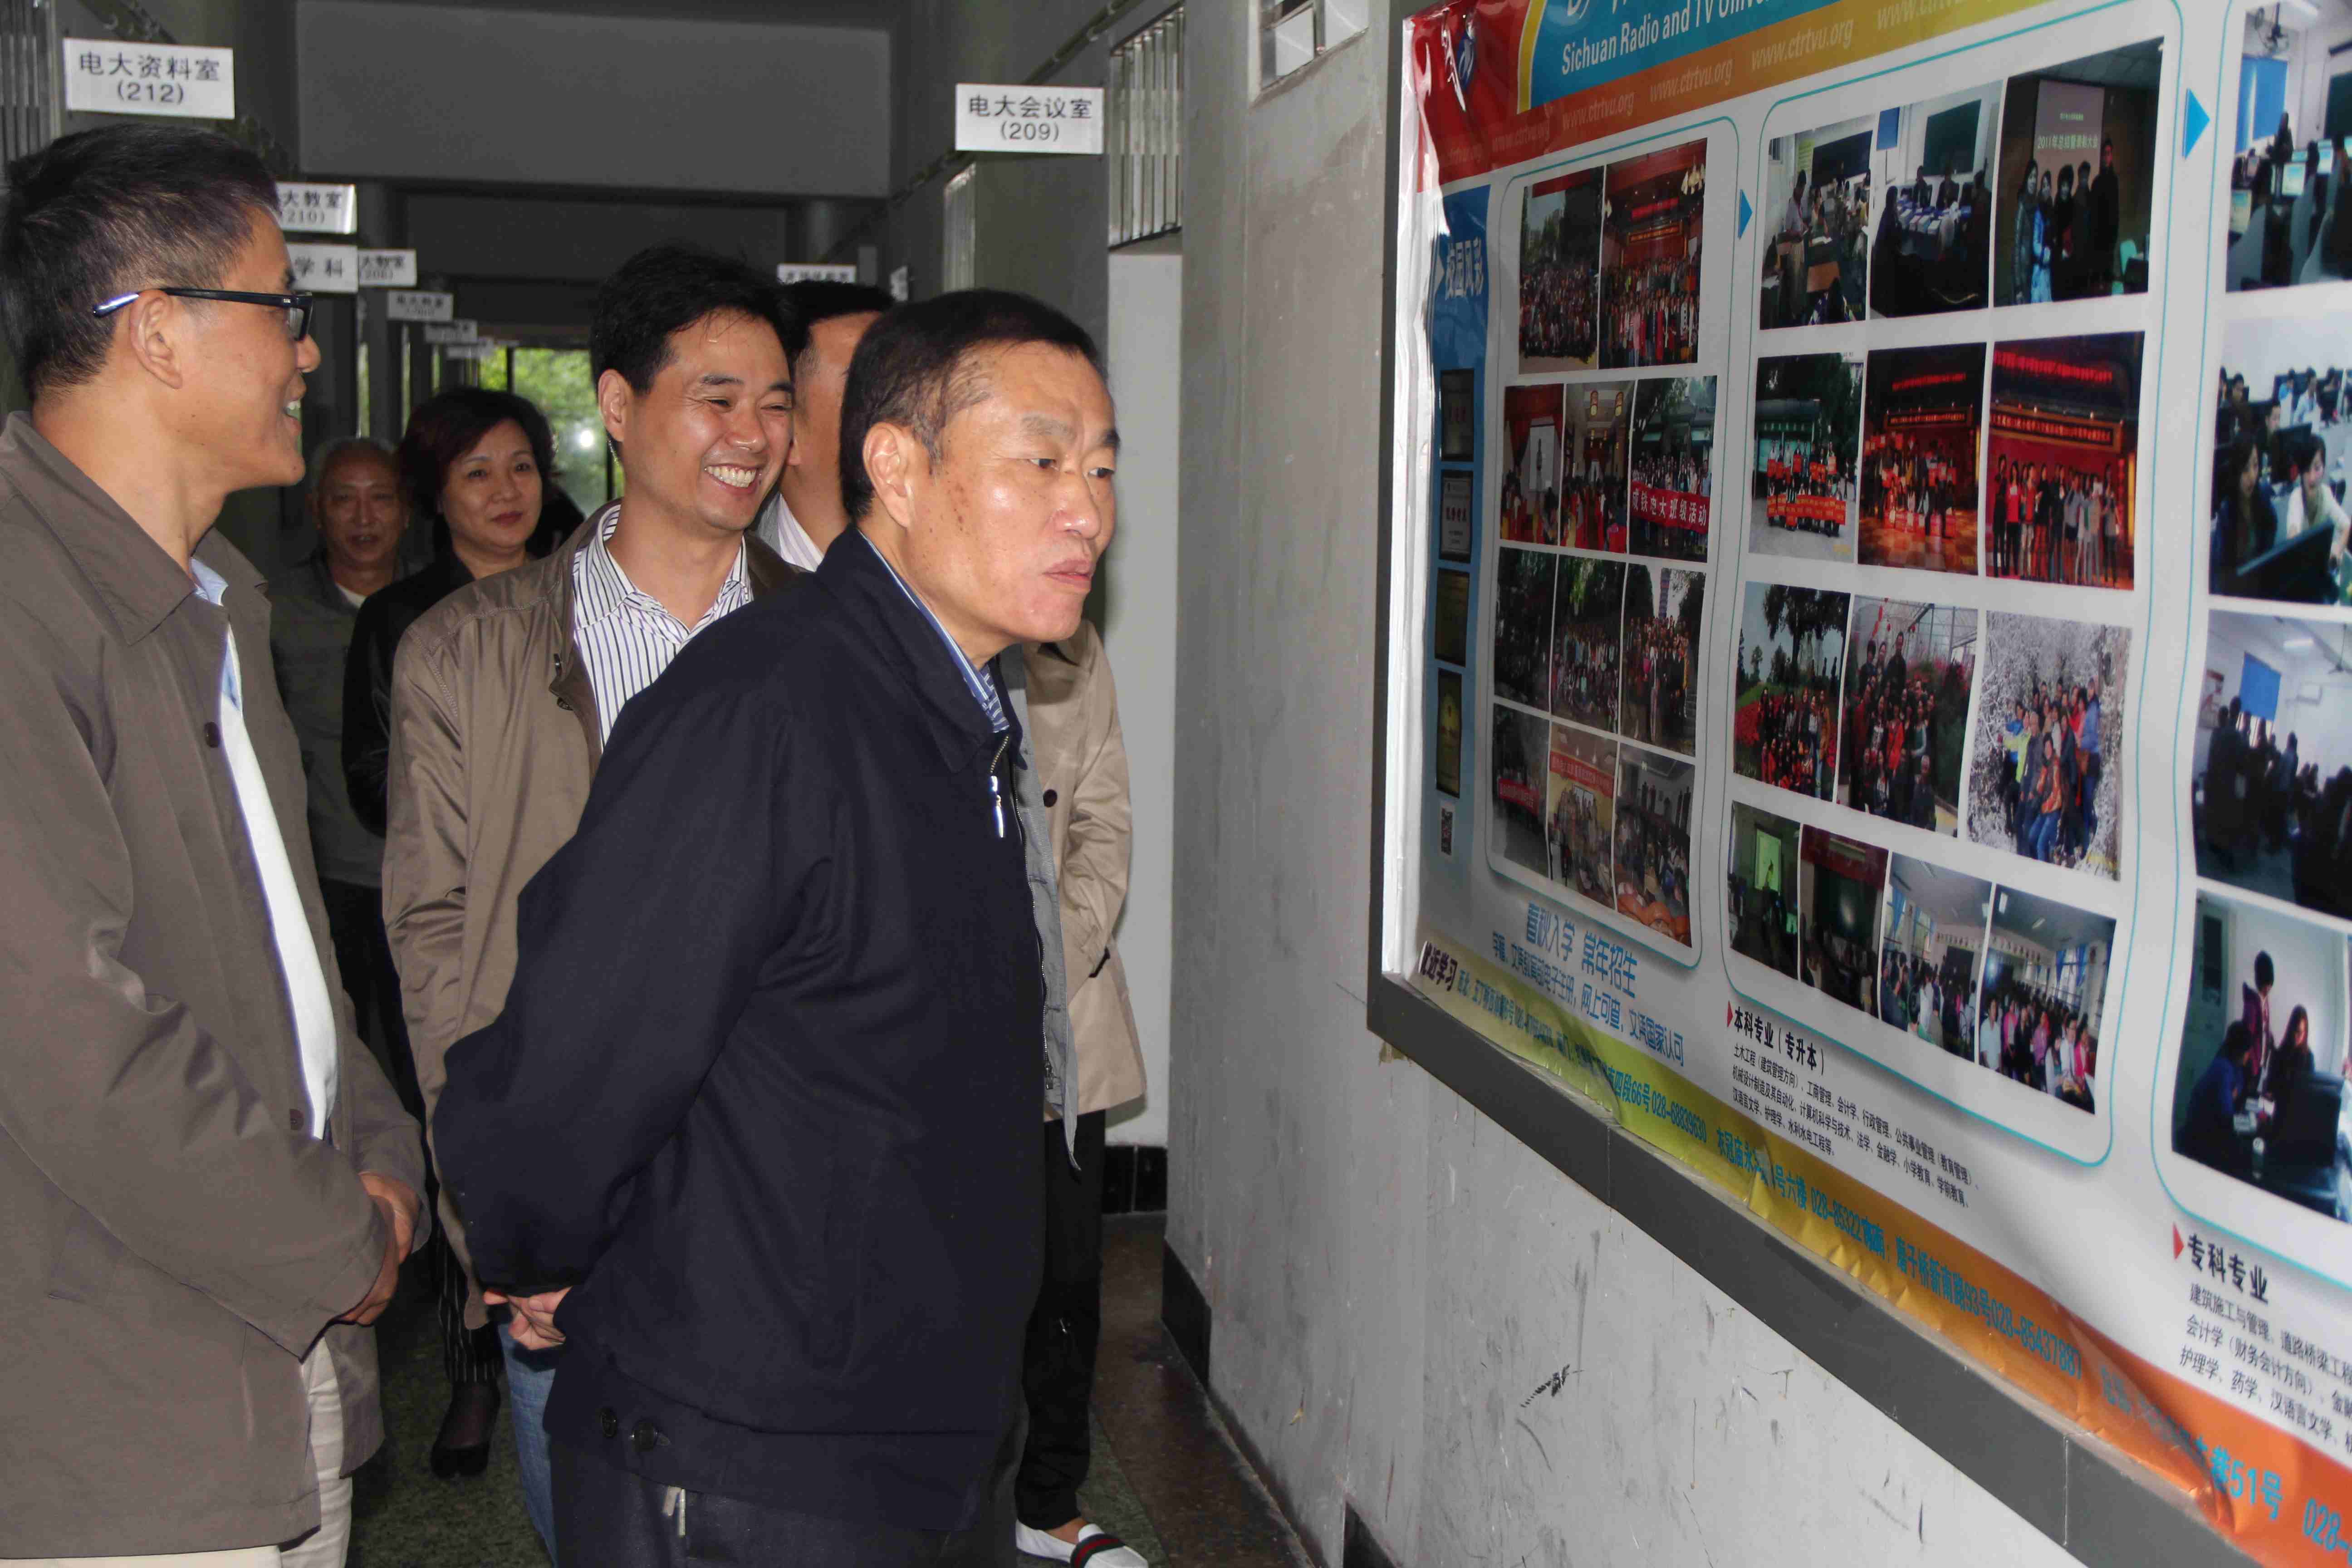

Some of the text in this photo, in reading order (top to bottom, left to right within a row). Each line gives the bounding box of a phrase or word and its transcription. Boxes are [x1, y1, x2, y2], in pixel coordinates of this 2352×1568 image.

[1561, 35, 1617, 76] Sichuan
[1620, 13, 1659, 55] Radio
[1662, 0, 1690, 40] and
[1750, 19, 1854, 71] www.ctrtvu.org
[80, 52, 220, 82] 电大资料室
[1649, 59, 1733, 102] www.ctrtvu.org
[118, 80, 184, 105] (212)
[968, 95, 1093, 120] 电大会议室
[1562, 91, 1635, 131] www.ctrtvu.org
[1000, 121, 1060, 142] (209)
[1632, 487, 1707, 527] 成铁电大班级活动
[1581, 931, 1638, 998] 常年招生
[2187, 1232, 2269, 1305] 专科专业
